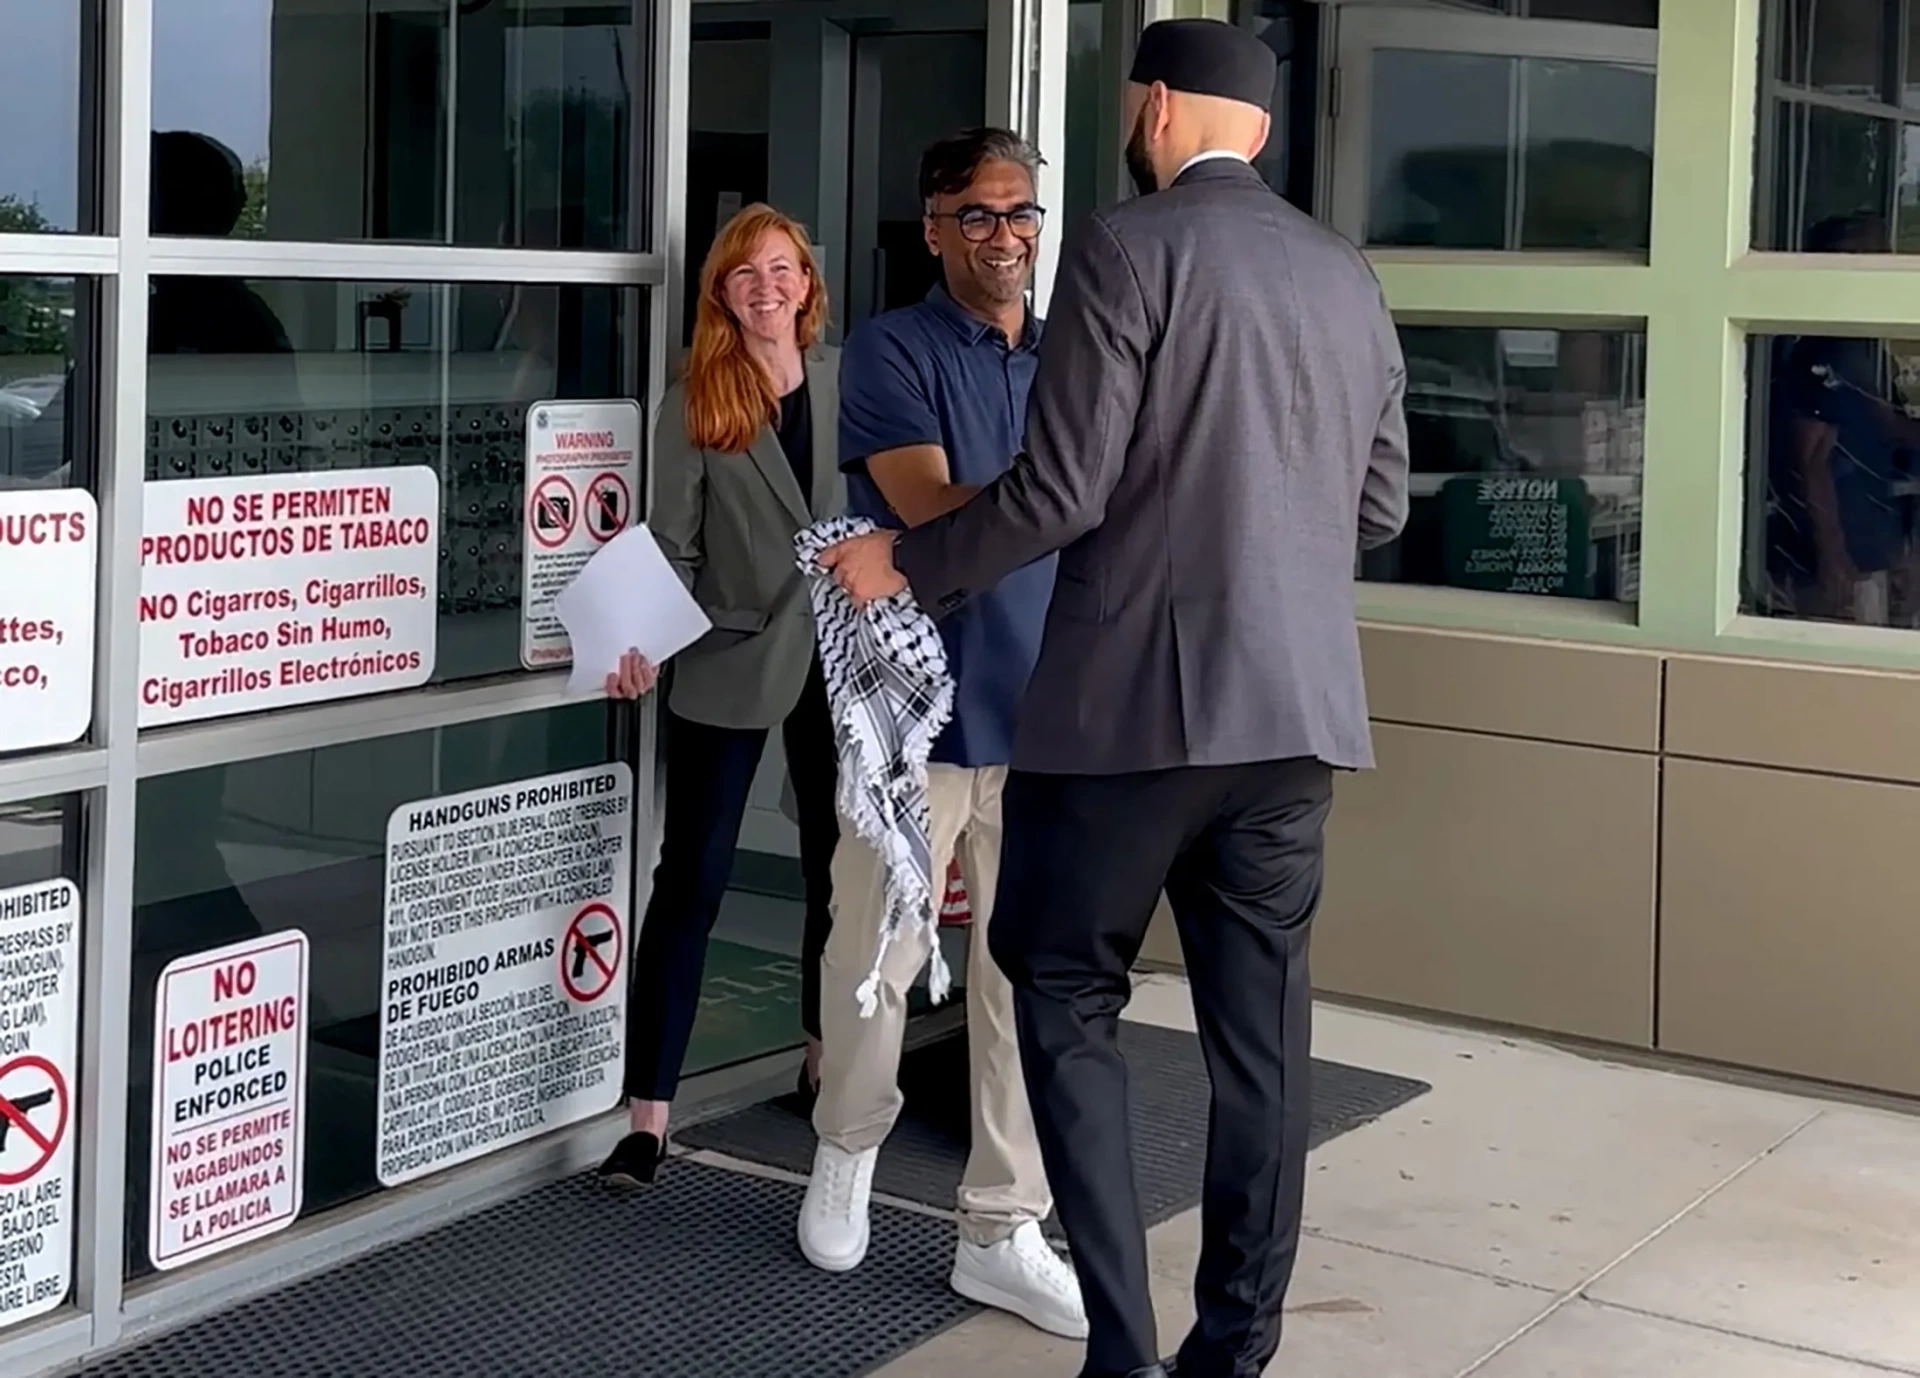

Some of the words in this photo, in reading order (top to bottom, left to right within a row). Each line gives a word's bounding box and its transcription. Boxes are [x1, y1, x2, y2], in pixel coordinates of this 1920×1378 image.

[555, 431, 615, 449] WARNING
[187, 496, 224, 525] NO
[232, 494, 263, 523] SE
[272, 486, 391, 520] PERMITEN
[141, 526, 294, 566] PRODUCTOS
[302, 524, 332, 553] DE
[340, 517, 429, 550] TABACO
[140, 594, 177, 622] NO
[187, 589, 297, 620] Cigarros,
[306, 573, 426, 608] Cigarrillos,
[180, 630, 268, 658] Tobaco
[277, 622, 313, 648] Sin
[322, 617, 391, 642] Humo,
[143, 668, 271, 708] Cigarrillos
[280, 651, 420, 686] Electrónicos
[409, 794, 510, 831] HANDGUNS
[516, 772, 616, 808] PROHIBITED
[390, 859, 429, 883] LICENSE
[503, 831, 554, 857] CONCEALED
[398, 879, 436, 902] PERSON
[438, 868, 482, 893] LICENSED
[431, 915, 462, 937] ENTER
[485, 898, 530, 923] PROPERTY
[563, 877, 612, 903] CONCEALED
[56, 921, 73, 945] BY
[213, 961, 256, 1002] NO
[388, 956, 489, 999] PROHIBIDO
[494, 938, 554, 970] ARMAS
[387, 1000, 411, 1023] DE
[417, 981, 479, 1015] FUEGO
[168, 996, 295, 1062] LOITERING
[194, 1044, 271, 1086] POLICE
[174, 1070, 287, 1122] ENFORCED
[167, 1141, 191, 1166] NO
[196, 1132, 217, 1156] SE
[221, 1109, 291, 1148] PERMITE
[173, 1139, 283, 1190] VAGABUNDOS
[35, 1177, 62, 1203] AIRE
[169, 1196, 191, 1220] SE
[195, 1170, 270, 1212] LLAMARA
[274, 1164, 286, 1184] A
[3, 1210, 34, 1239] BAJO
[37, 1204, 59, 1229] DEL
[183, 1219, 203, 1243] LA
[208, 1196, 272, 1235] POLICIA
[26, 1274, 62, 1304] LIBRE
